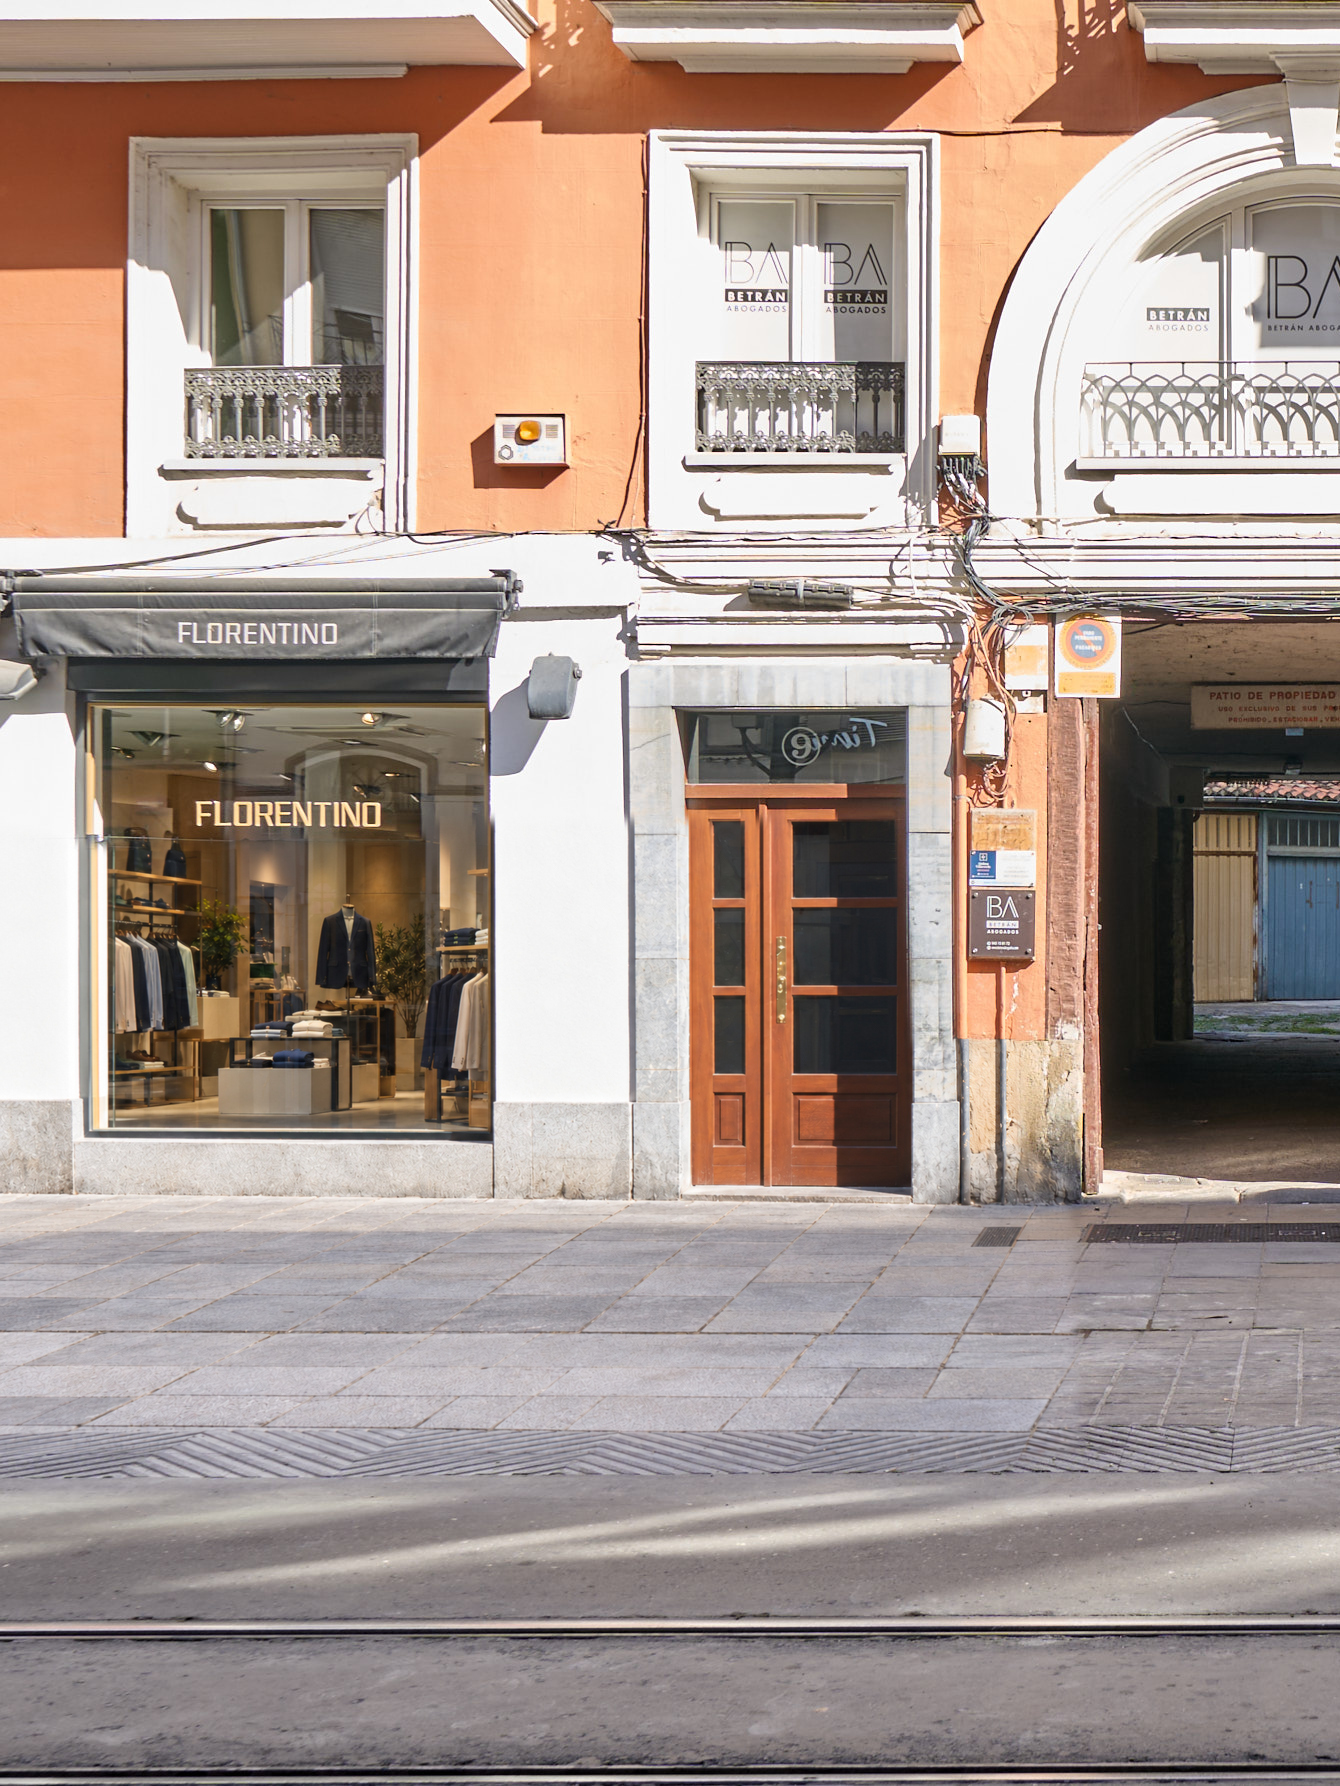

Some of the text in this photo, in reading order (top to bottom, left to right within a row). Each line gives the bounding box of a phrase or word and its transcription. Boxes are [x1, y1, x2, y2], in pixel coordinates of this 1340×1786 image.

[824, 243, 888, 285] BA
[727, 289, 786, 302] BETRÁN
[827, 291, 886, 303] BETRÁN
[726, 305, 787, 313] ABOGADOS
[826, 306, 887, 314] ABOGADOS
[1149, 308, 1209, 322] BETRÁN
[1148, 324, 1209, 332] ABOGADOS
[1267, 323, 1304, 331] BETRÁN
[178, 622, 338, 644] FLORENTINO
[1209, 691, 1241, 700] PATIO
[1247, 691, 1263, 700] DE
[1269, 691, 1336, 700] PROPIEDAD
[195, 800, 382, 827] FLORENTINO
